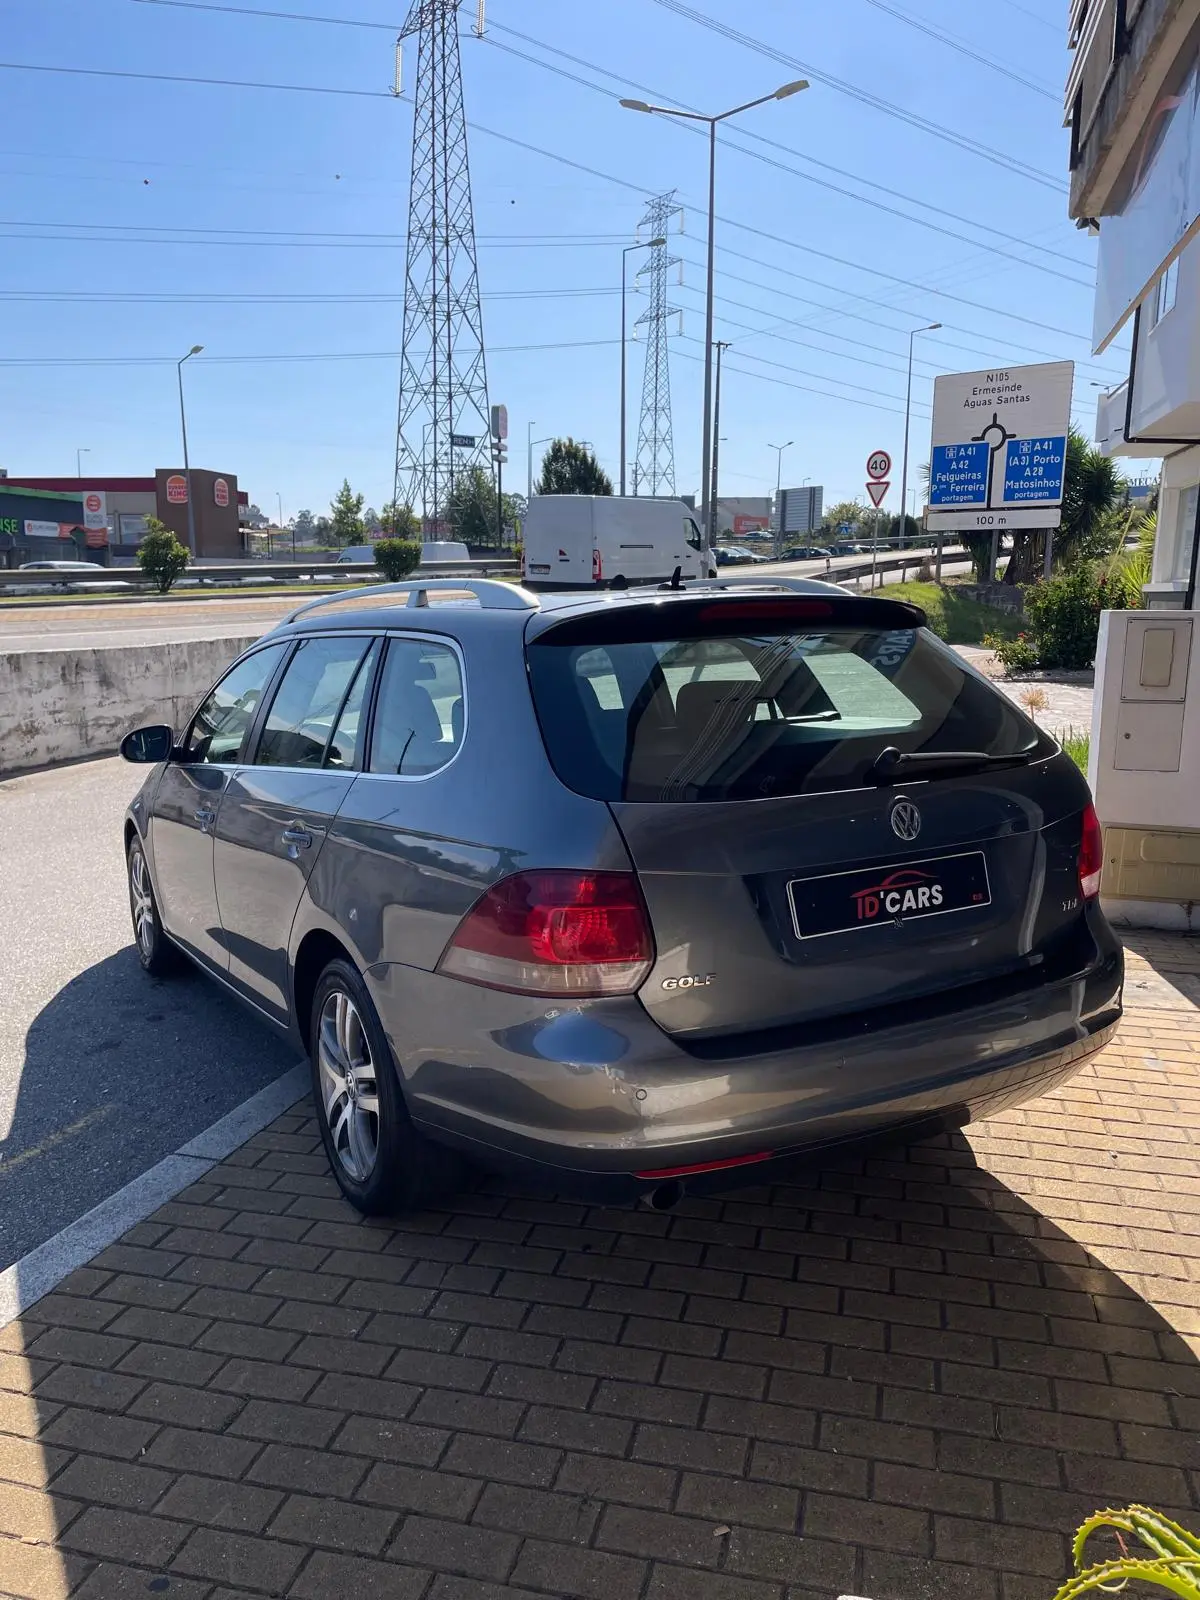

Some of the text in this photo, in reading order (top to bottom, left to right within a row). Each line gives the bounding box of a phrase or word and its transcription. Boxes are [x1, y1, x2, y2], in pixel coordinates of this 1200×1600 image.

[972, 383, 1022, 396] Ermesinde
[996, 394, 1030, 405] Santas
[870, 459, 887, 471] 40
[1033, 455, 1061, 465] Porto
[936, 471, 982, 483] Felgueiras
[950, 482, 985, 493] Ferreira
[1005, 479, 1061, 490] Matosinhos
[941, 493, 974, 503] portagem
[1014, 490, 1049, 500] portagem
[976, 515, 1007, 525] 100 m
[661, 972, 717, 990] GOLF
